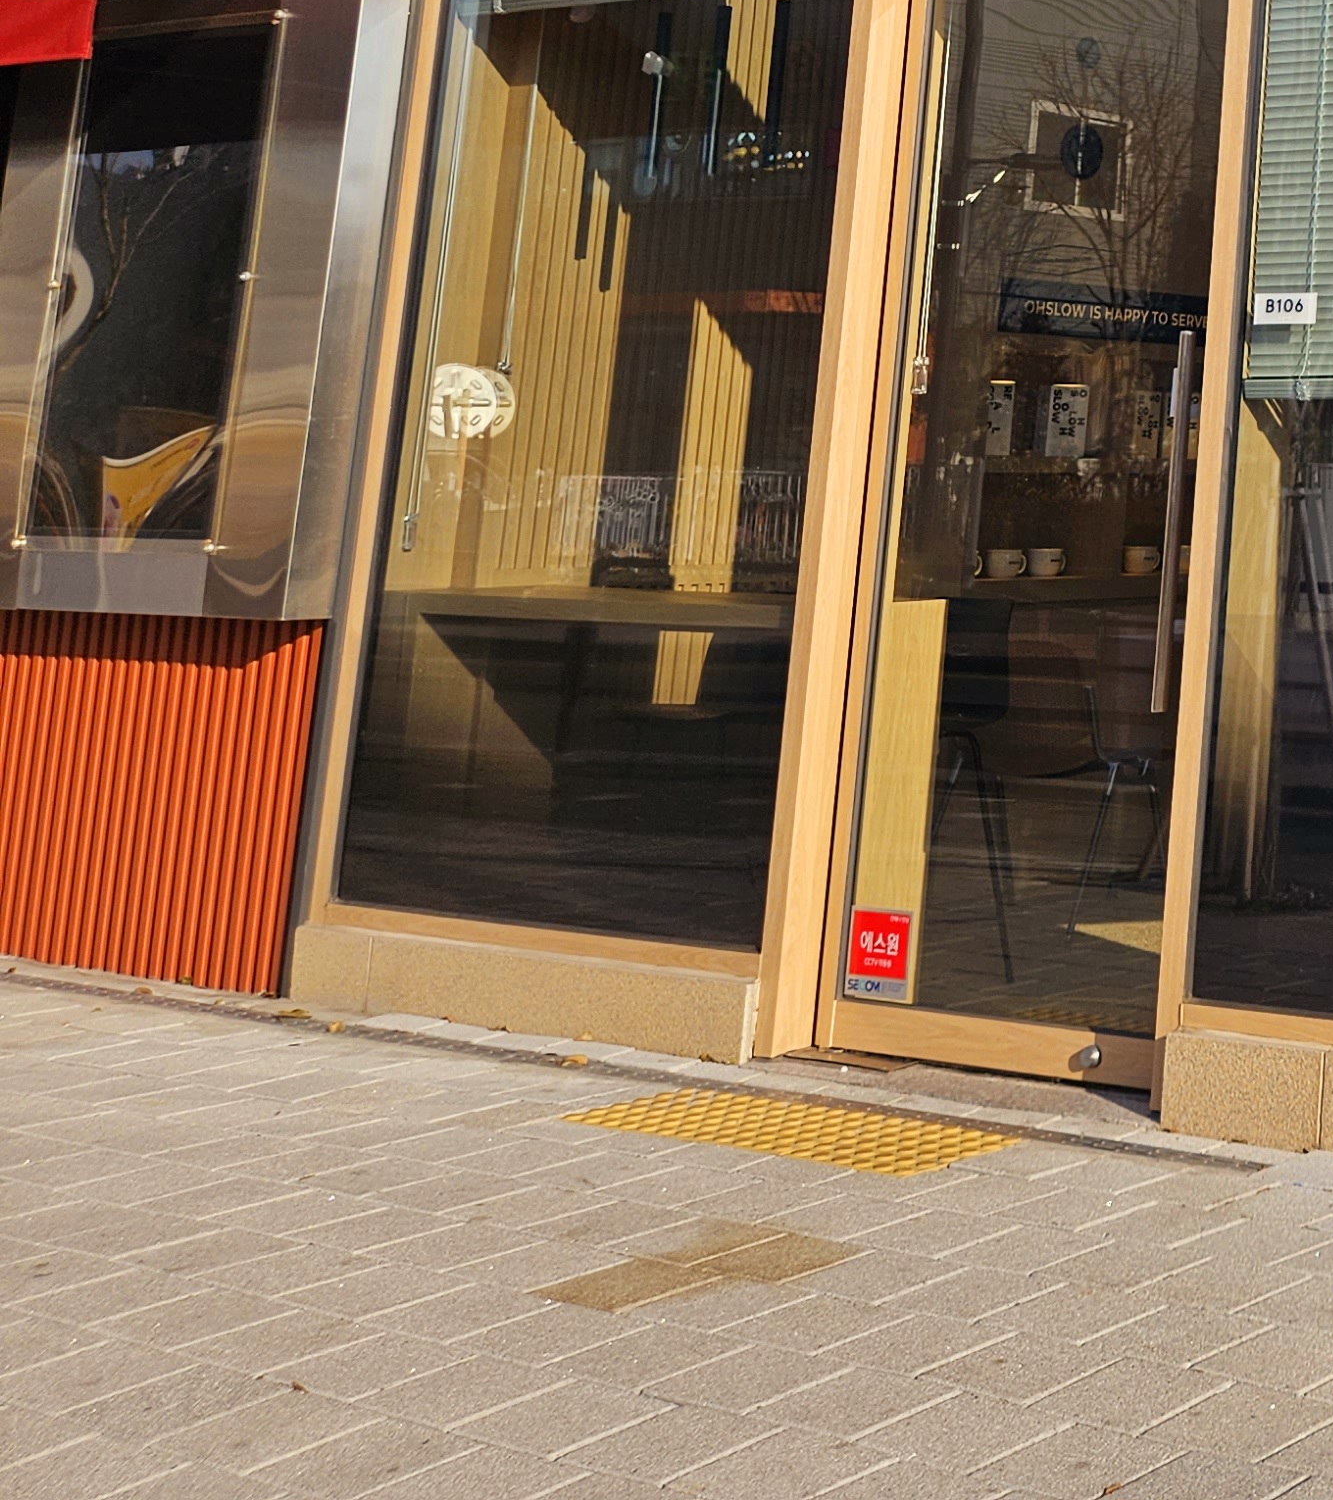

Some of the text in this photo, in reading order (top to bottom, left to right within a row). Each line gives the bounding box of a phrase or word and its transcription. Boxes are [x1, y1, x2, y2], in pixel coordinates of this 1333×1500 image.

[1024, 299, 1086, 319] OHSLOW
[1089, 305, 1101, 320] IS
[1105, 308, 1149, 324] HAPPY
[1152, 311, 1169, 325] TO
[1265, 298, 1303, 313] B106
[860, 930, 900, 956] 에스원
[847, 978, 881, 993] SECOM
